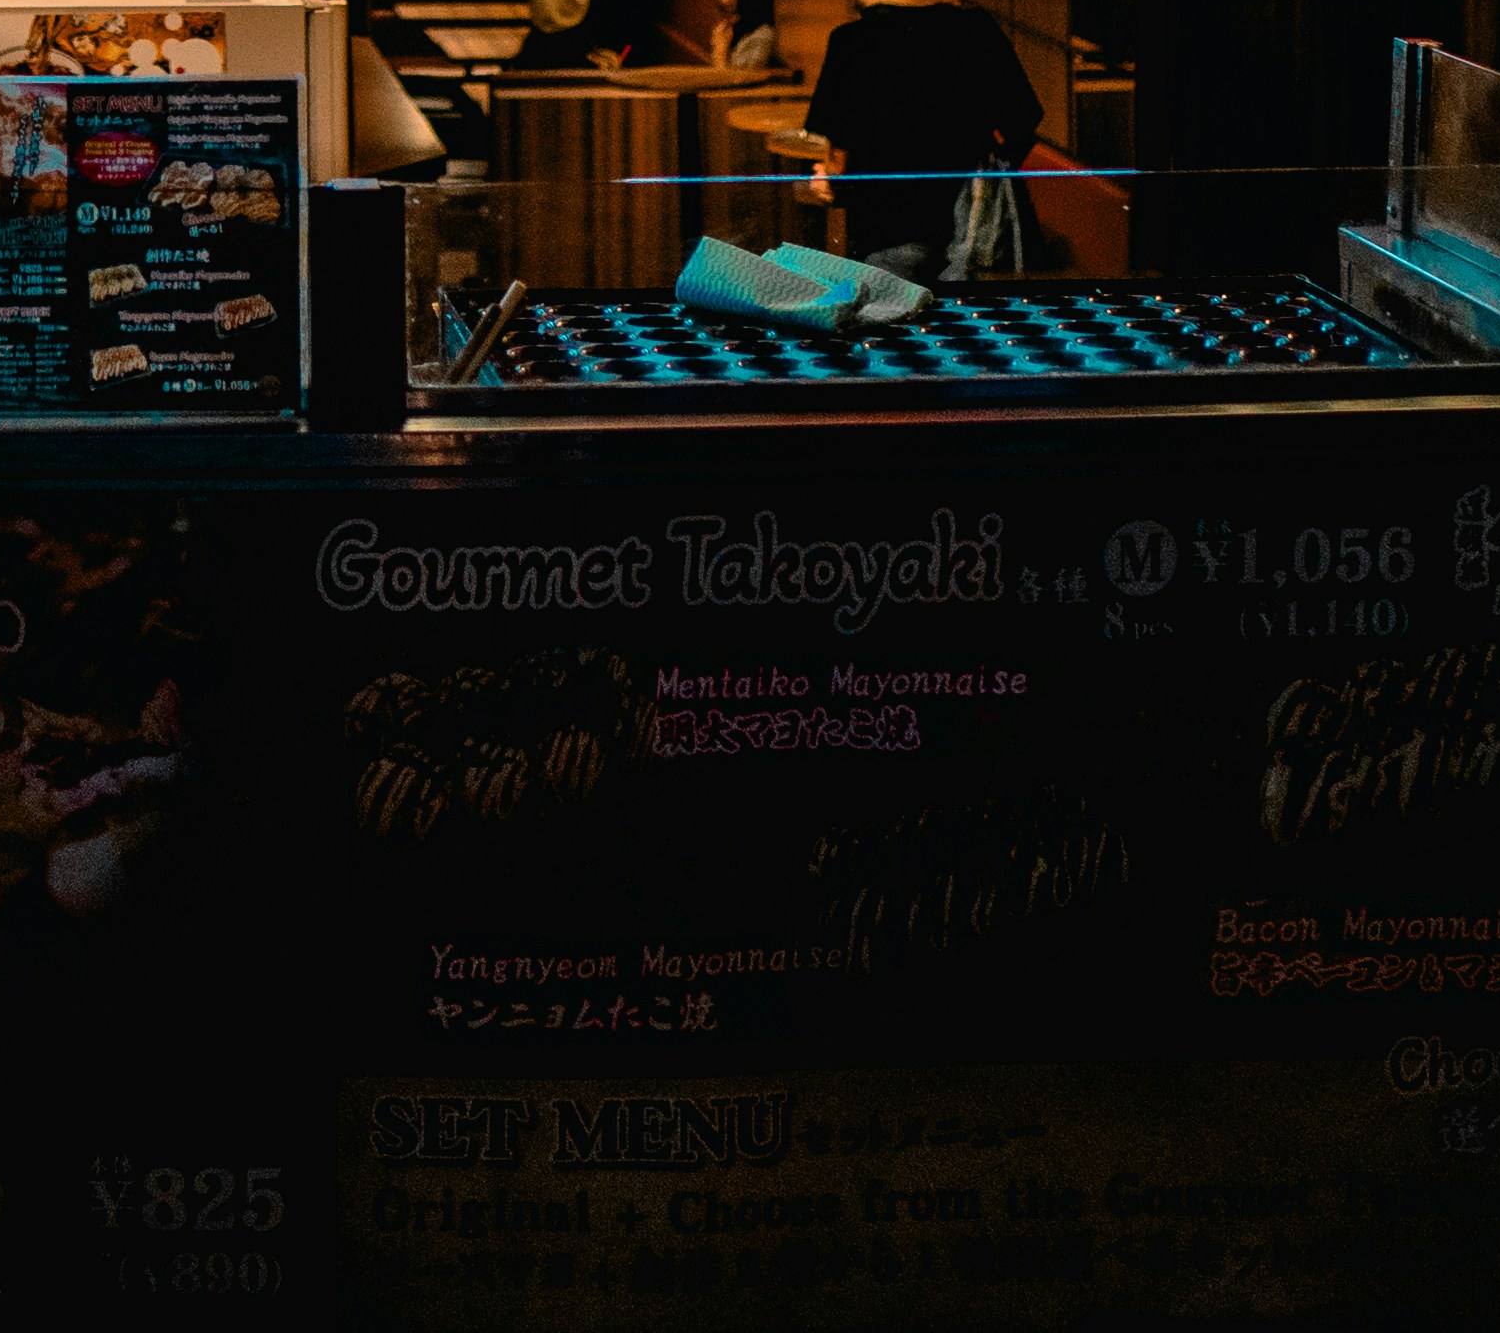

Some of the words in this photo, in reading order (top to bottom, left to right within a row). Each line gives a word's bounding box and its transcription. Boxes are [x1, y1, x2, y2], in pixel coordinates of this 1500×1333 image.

[315, 516, 655, 613] Gourmet
[665, 507, 1006, 635] Takoyaki
[1191, 525, 1417, 590] ¥1,056
[655, 662, 811, 701] Mentaiko
[829, 661, 1030, 702] Mayonnaise
[1214, 907, 1322, 946] Bacon
[428, 941, 619, 986] Yangnyeom
[640, 940, 844, 984] Mayonnaise
[426, 990, 722, 1034] ヤンニョムたこ焼
[367, 1093, 535, 1168] SET
[548, 1091, 797, 1171] MENU
[88, 1164, 288, 1235] ¥825
[373, 1184, 590, 1241] Original
[668, 1190, 840, 1238] Choose
[860, 1178, 981, 1227] from
[1008, 1175, 1084, 1220] the
